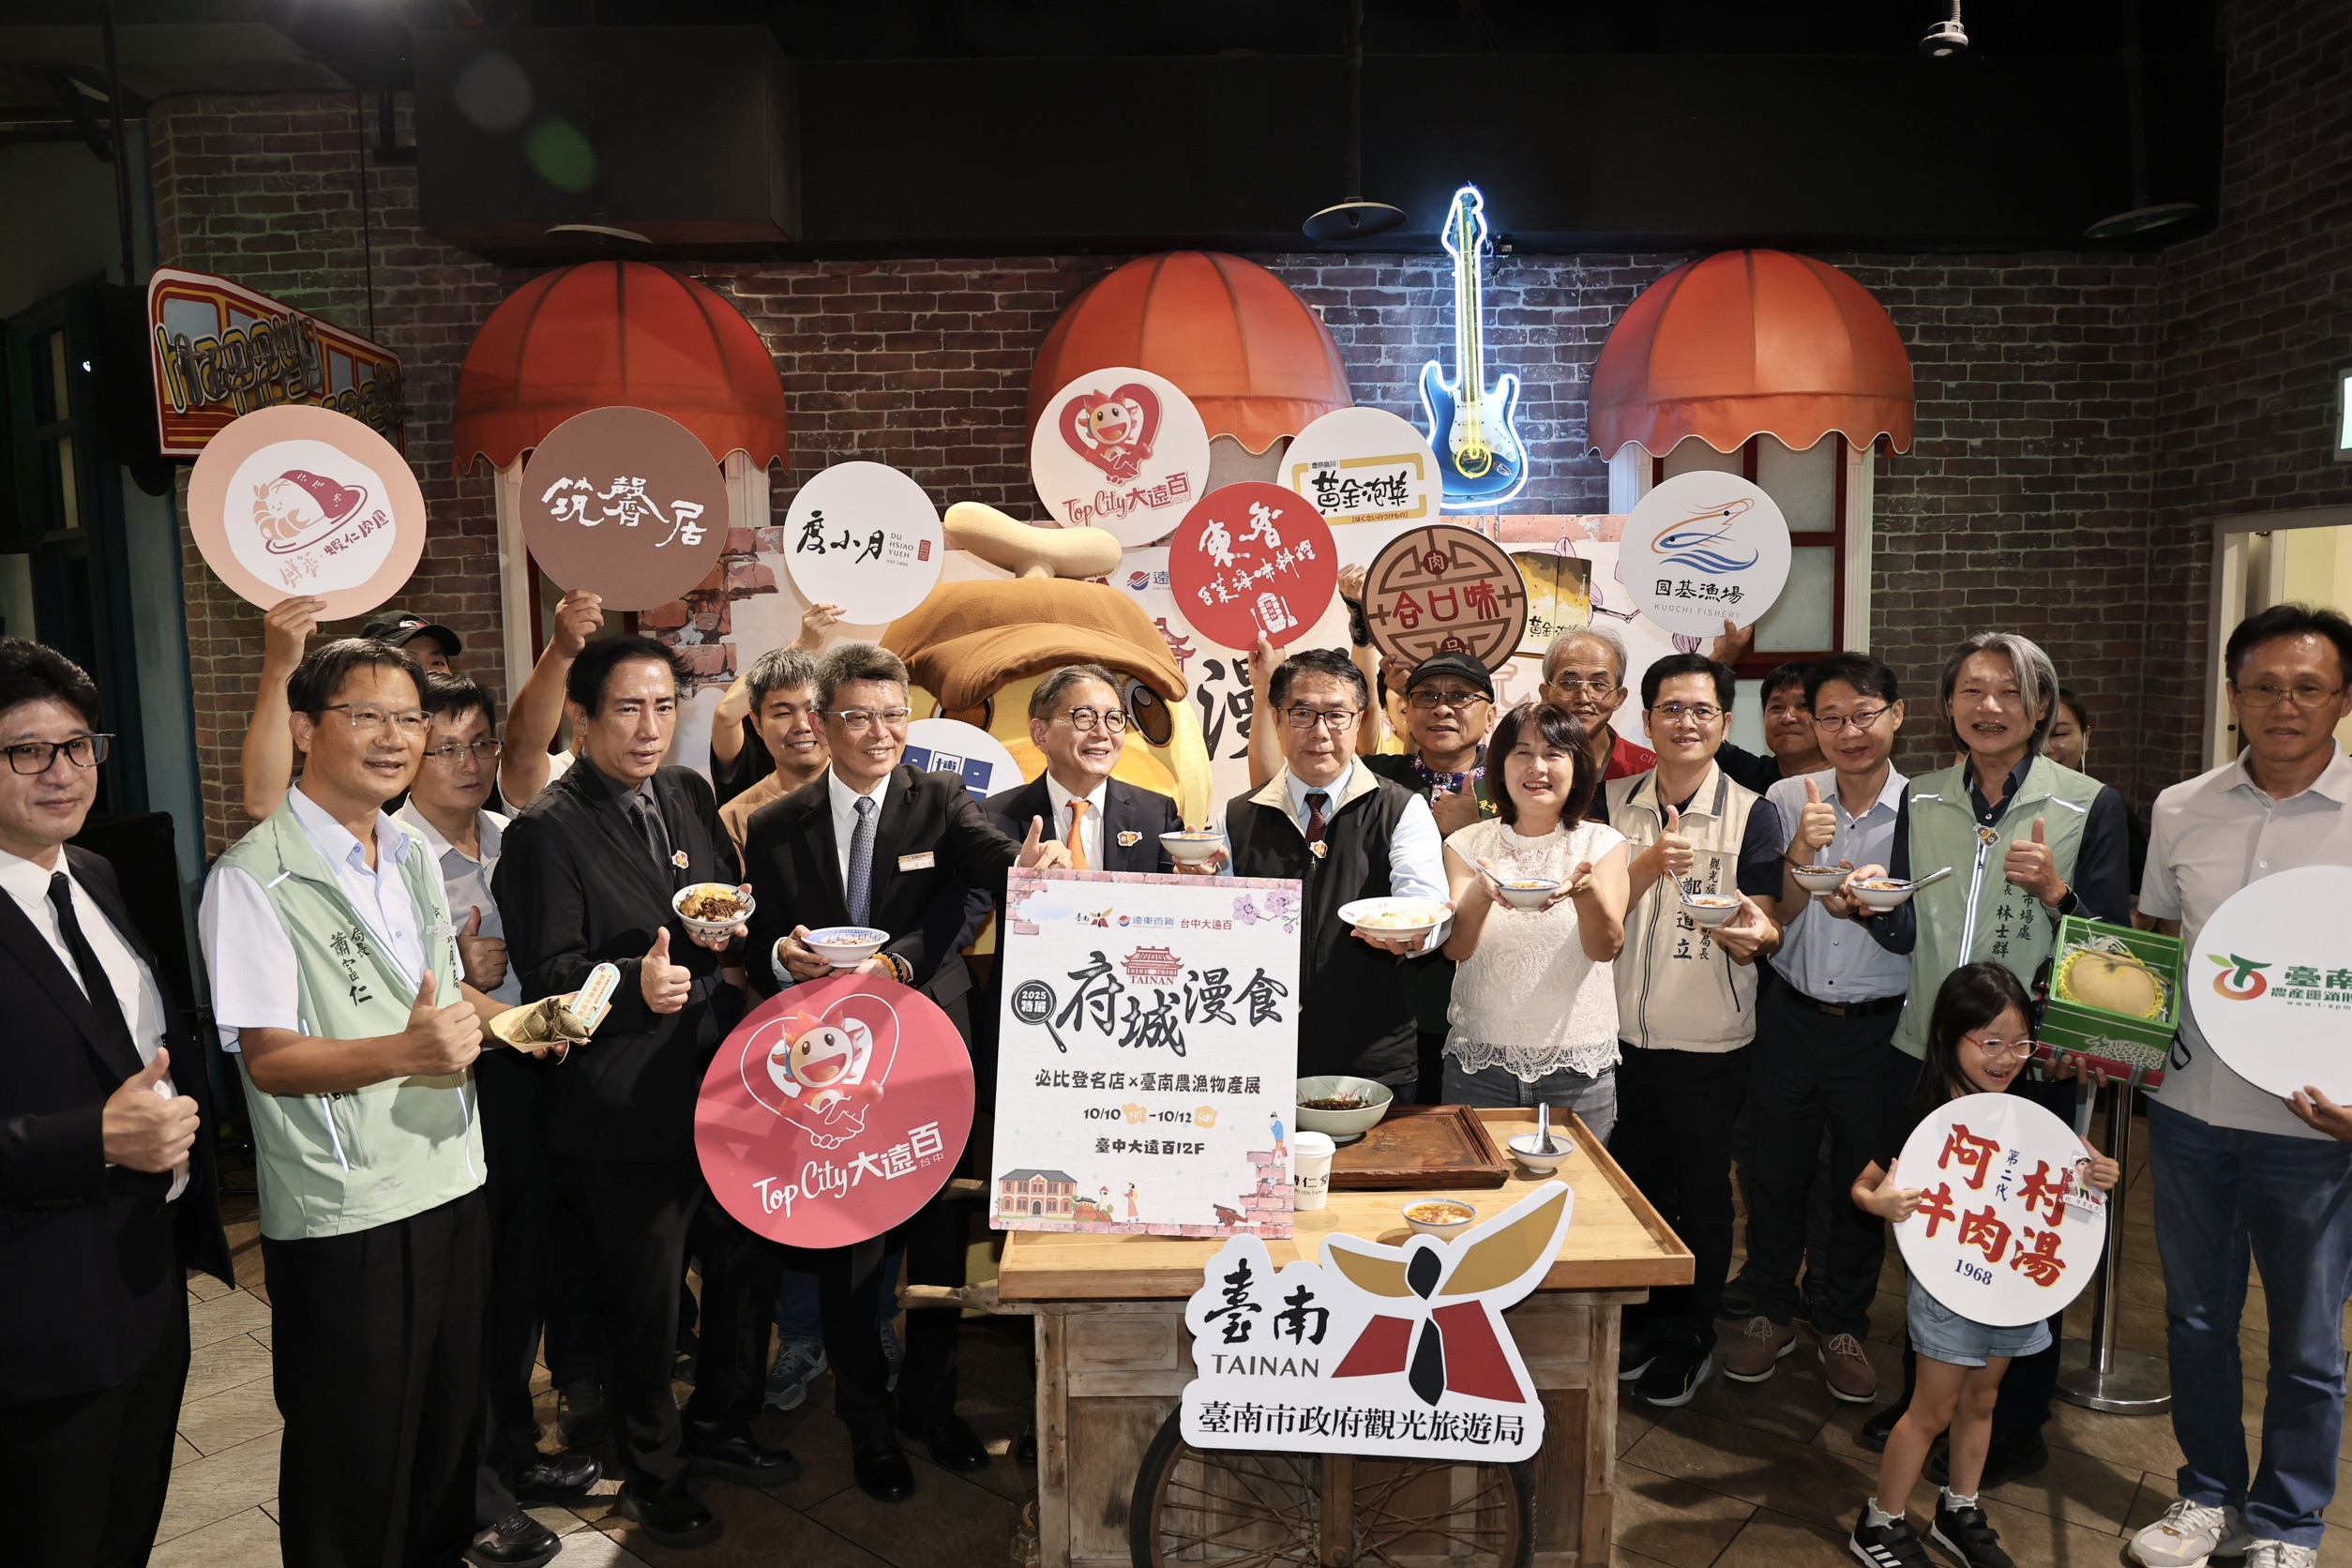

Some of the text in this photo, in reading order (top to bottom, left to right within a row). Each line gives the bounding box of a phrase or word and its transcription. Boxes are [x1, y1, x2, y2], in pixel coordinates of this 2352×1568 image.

[1125, 472, 1189, 511] 大遠百
[1311, 470, 1409, 516] 黃金泡菜
[796, 509, 885, 565] 度小月
[889, 540, 914, 551] HSIAO
[890, 533, 902, 541] DU
[888, 549, 910, 559] YUEH
[1427, 552, 1445, 571] 肉
[1392, 579, 1500, 630] 合口味
[1654, 579, 1745, 605] 國基漁場
[1654, 603, 1741, 619] KUOCHI FISHERY
[1180, 918, 1233, 930] 台中大遠百
[1992, 904, 2013, 958] 林士群
[1128, 974, 1175, 986] TAINAN
[1020, 1000, 1048, 1014] 特展
[1021, 990, 1048, 1002] 2025
[1055, 949, 1289, 1058] 府城漫食
[1083, 1108, 1122, 1121] 10/10
[847, 1121, 944, 1188] 大遠百
[919, 1153, 945, 1168] 台中
[1995, 1149, 2020, 1203] 第二代
[1916, 1182, 2067, 1289] 牛肉湯
[1954, 1259, 1994, 1286] 1968
[1203, 1258, 1330, 1347] 臺南
[1211, 1353, 1319, 1379] TAINAN
[1198, 1399, 1525, 1447] 臺南市政府觀光旅遊局
